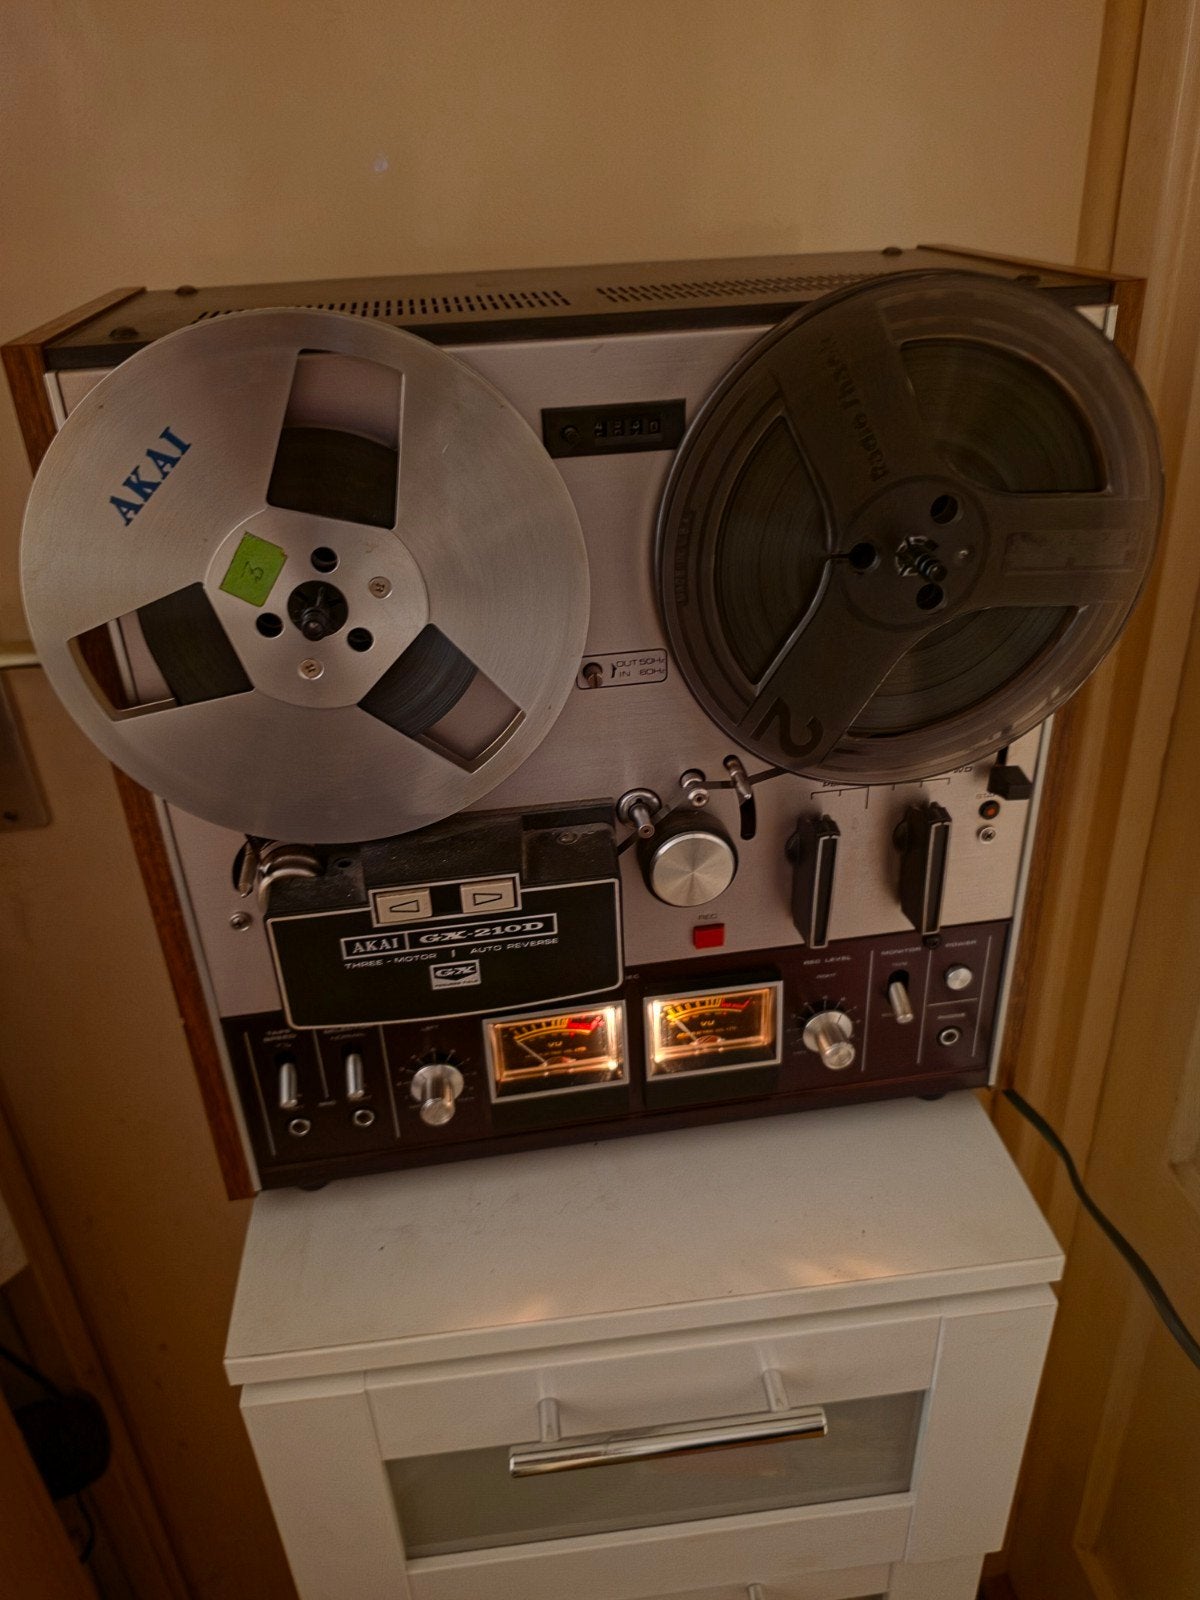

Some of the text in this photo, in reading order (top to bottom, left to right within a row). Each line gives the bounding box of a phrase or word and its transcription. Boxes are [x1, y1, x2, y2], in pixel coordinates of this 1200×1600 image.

[109, 425, 192, 527] AKAI
[616, 659, 638, 668] OUT
[750, 696, 824, 758] 2
[351, 920, 545, 955] AKAI GX-210D
[344, 958, 385, 971] THREE
[393, 951, 439, 965] MOTOR
[469, 944, 503, 955] AUTO
[506, 937, 561, 950] REVERSE
[880, 945, 922, 956] MONITOR
[434, 964, 477, 978] GX
[699, 1018, 716, 1027] VU
